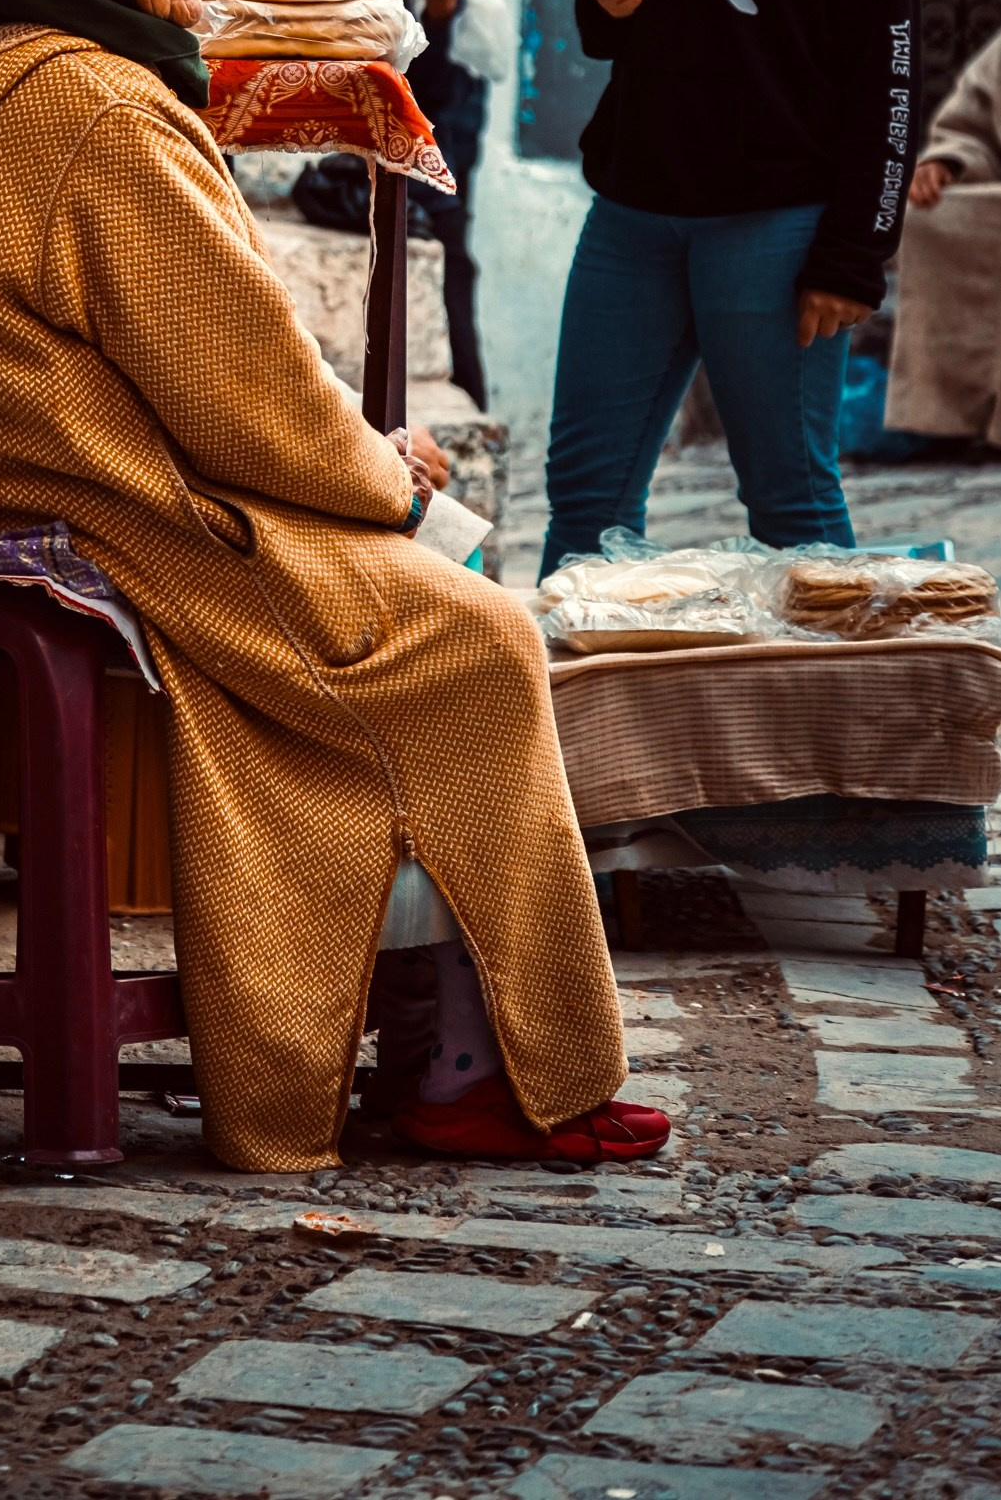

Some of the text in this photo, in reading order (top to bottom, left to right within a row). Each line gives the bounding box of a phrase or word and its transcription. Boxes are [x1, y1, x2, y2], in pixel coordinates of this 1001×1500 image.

[874, 19, 911, 232] THE PEEP SHOW
